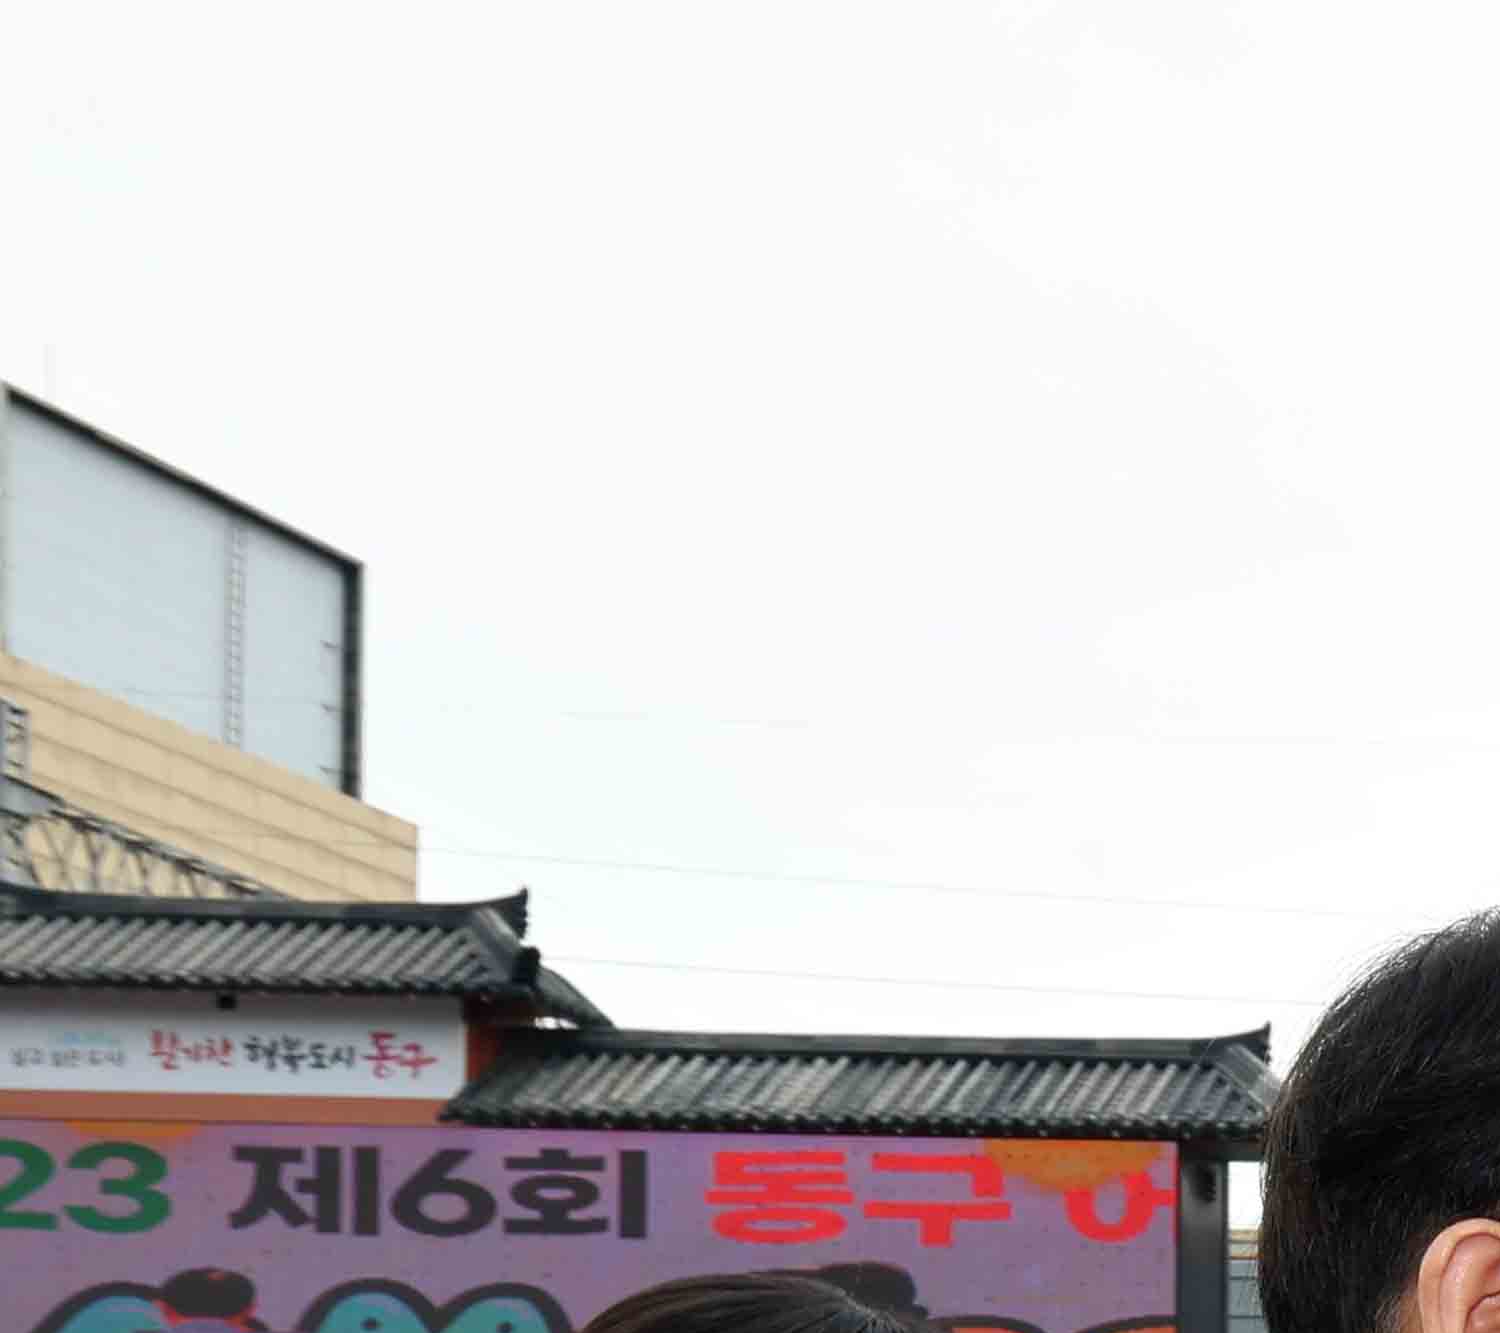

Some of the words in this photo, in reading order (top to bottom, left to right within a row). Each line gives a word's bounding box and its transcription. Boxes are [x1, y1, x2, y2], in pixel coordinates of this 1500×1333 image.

[363, 1031, 438, 1080] 동구
[228, 1144, 648, 1239] 제6회
[705, 1150, 1012, 1248] 동구
